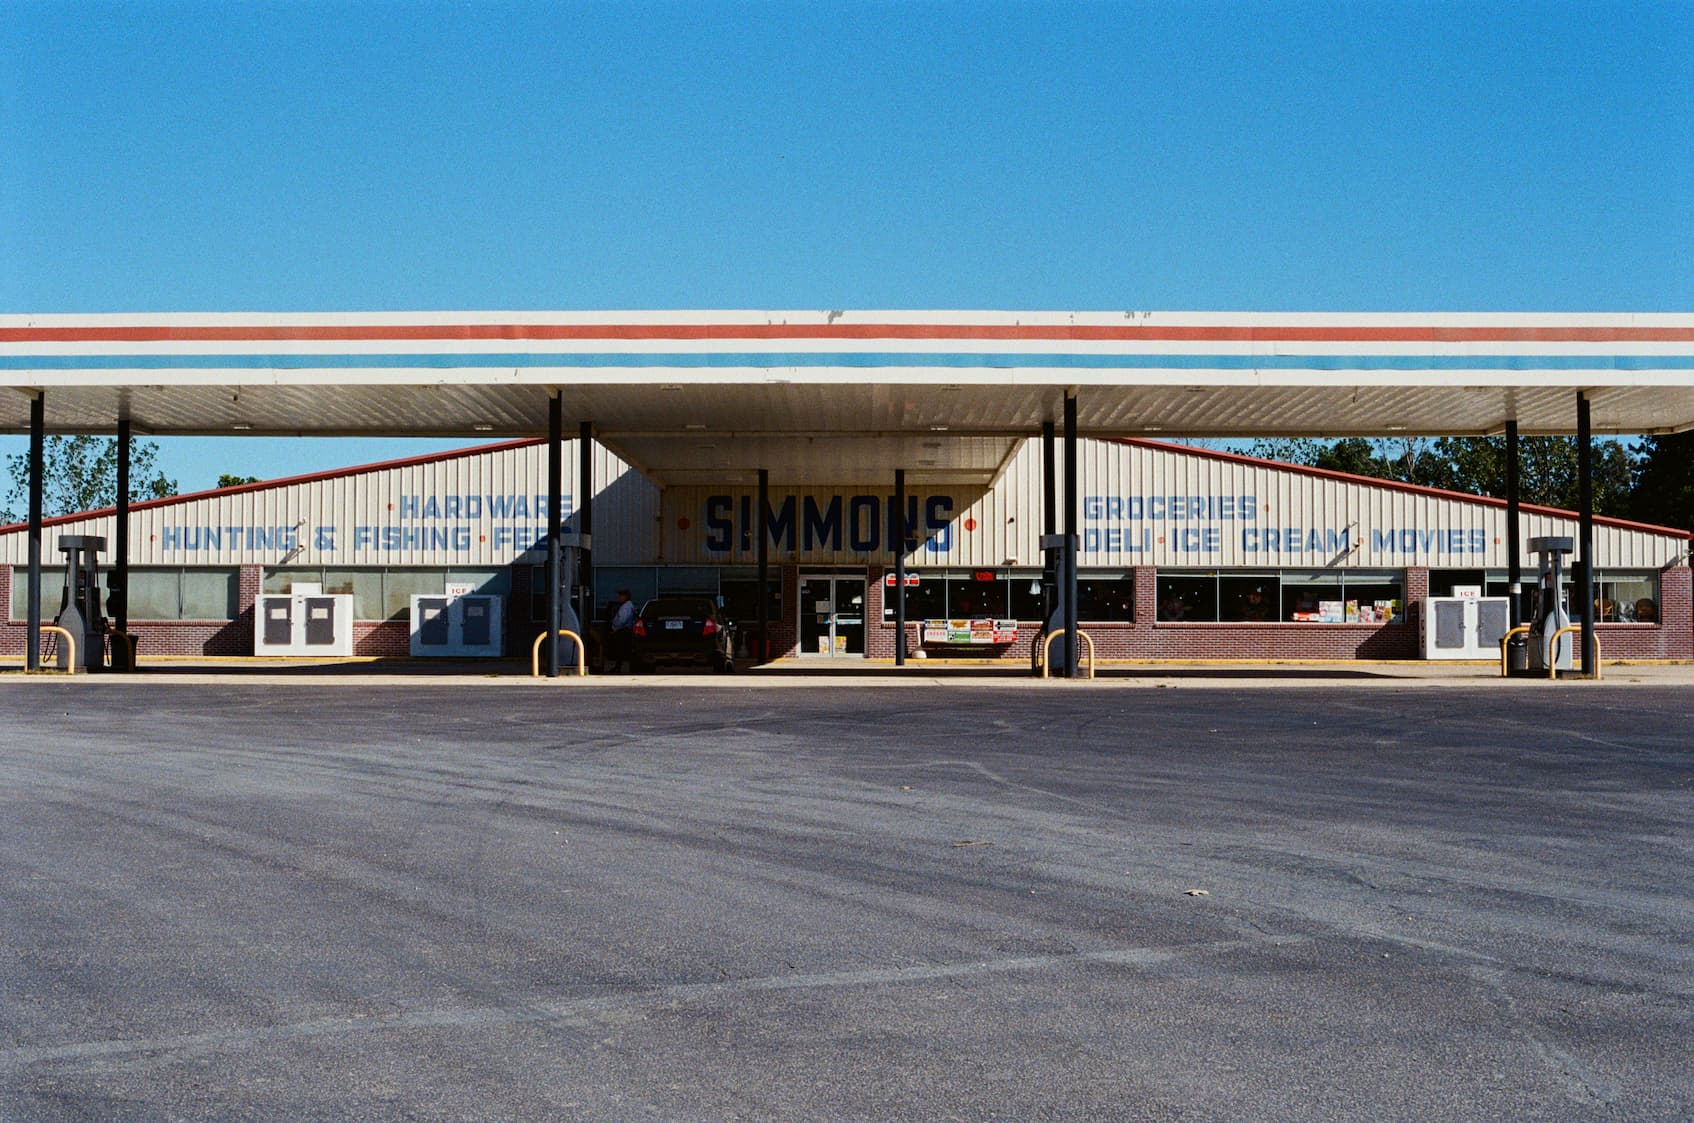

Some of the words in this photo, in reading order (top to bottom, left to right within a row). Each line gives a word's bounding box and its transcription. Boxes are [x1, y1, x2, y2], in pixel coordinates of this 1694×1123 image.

[400, 495, 572, 519] HARDWARE
[1084, 496, 1257, 520] GROCERIES
[706, 494, 953, 552] SIMMONS
[162, 526, 294, 551] HUNTING
[313, 526, 337, 551] &
[355, 526, 470, 551] FISHING
[494, 527, 573, 551] FEE
[1084, 528, 1150, 552] DELI
[1172, 528, 1220, 552] ICE
[1242, 528, 1350, 553] CREAM
[1373, 529, 1486, 553] MOVIES
